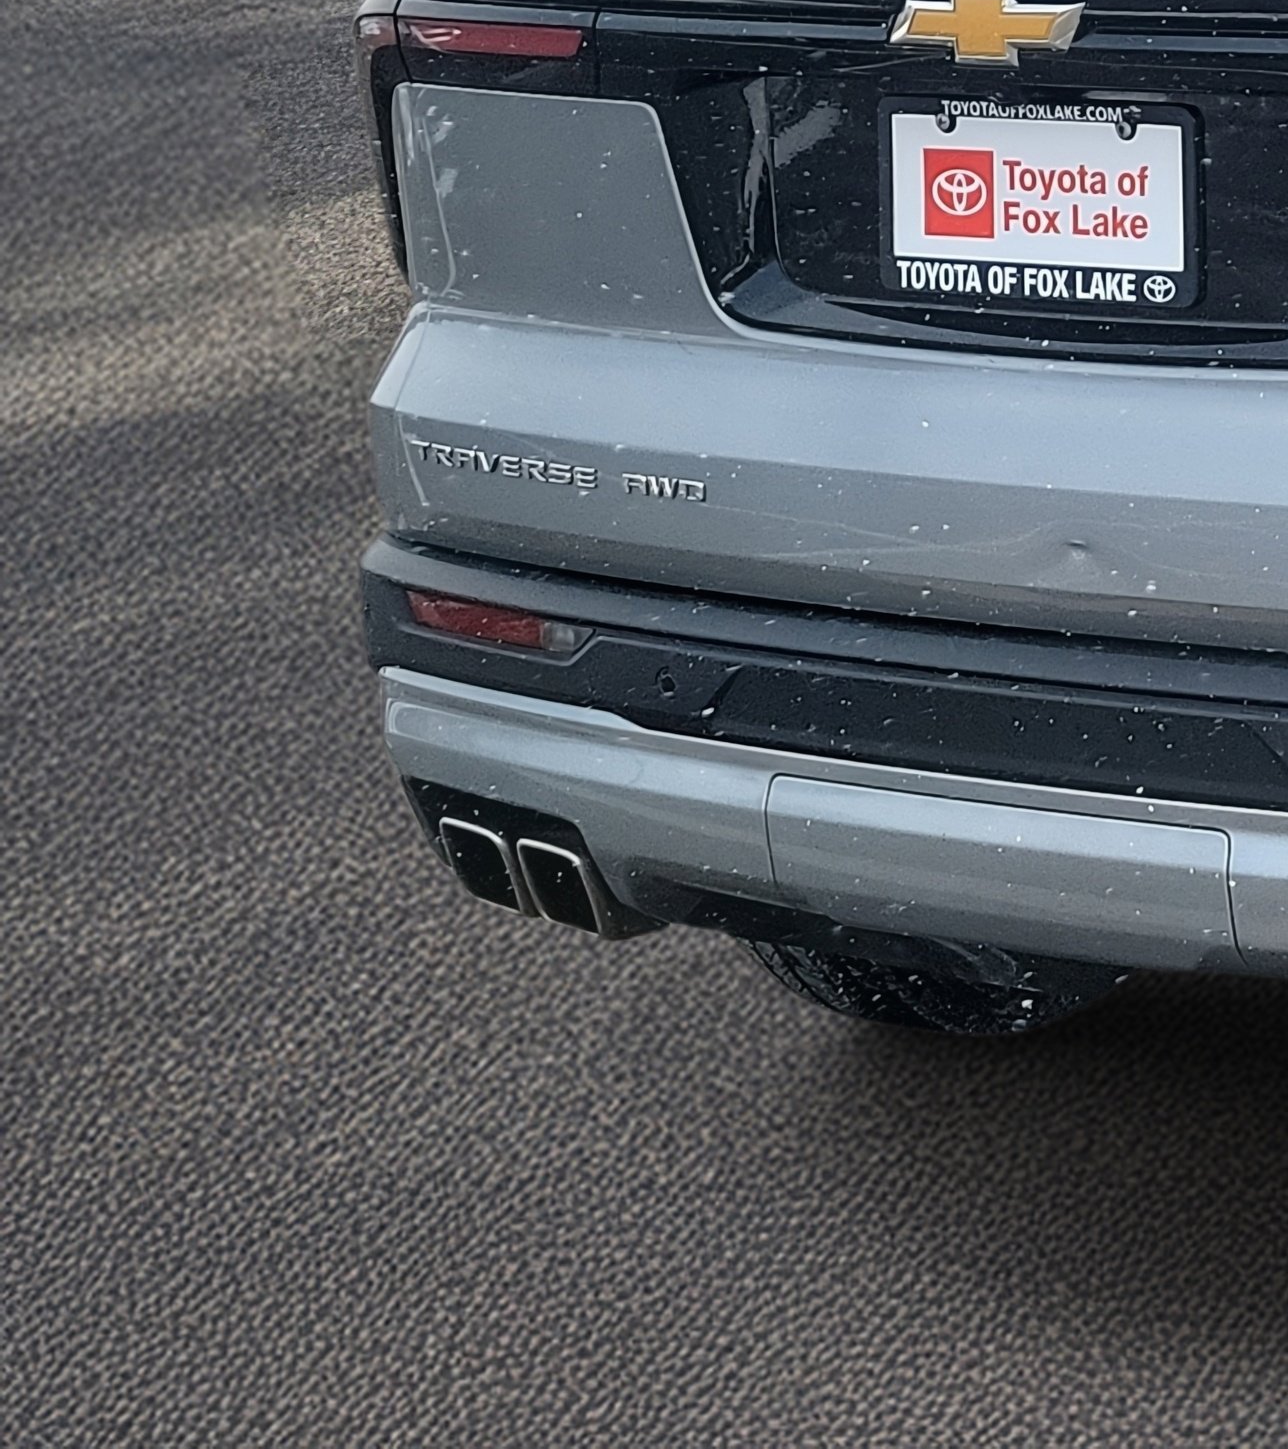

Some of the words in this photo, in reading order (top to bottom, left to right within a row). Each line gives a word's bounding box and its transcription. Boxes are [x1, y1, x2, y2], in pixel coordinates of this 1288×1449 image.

[1003, 159, 1106, 200] Toyota
[1117, 166, 1149, 197] of
[1003, 201, 1061, 235] Fox
[1072, 204, 1148, 239] Lake
[897, 260, 982, 293] TOYOTA
[988, 265, 1018, 295] OF
[1023, 268, 1069, 299] FOX
[1075, 271, 1137, 302] LAKE
[409, 439, 600, 489] TRAVERSE
[621, 472, 706, 503] AWD
